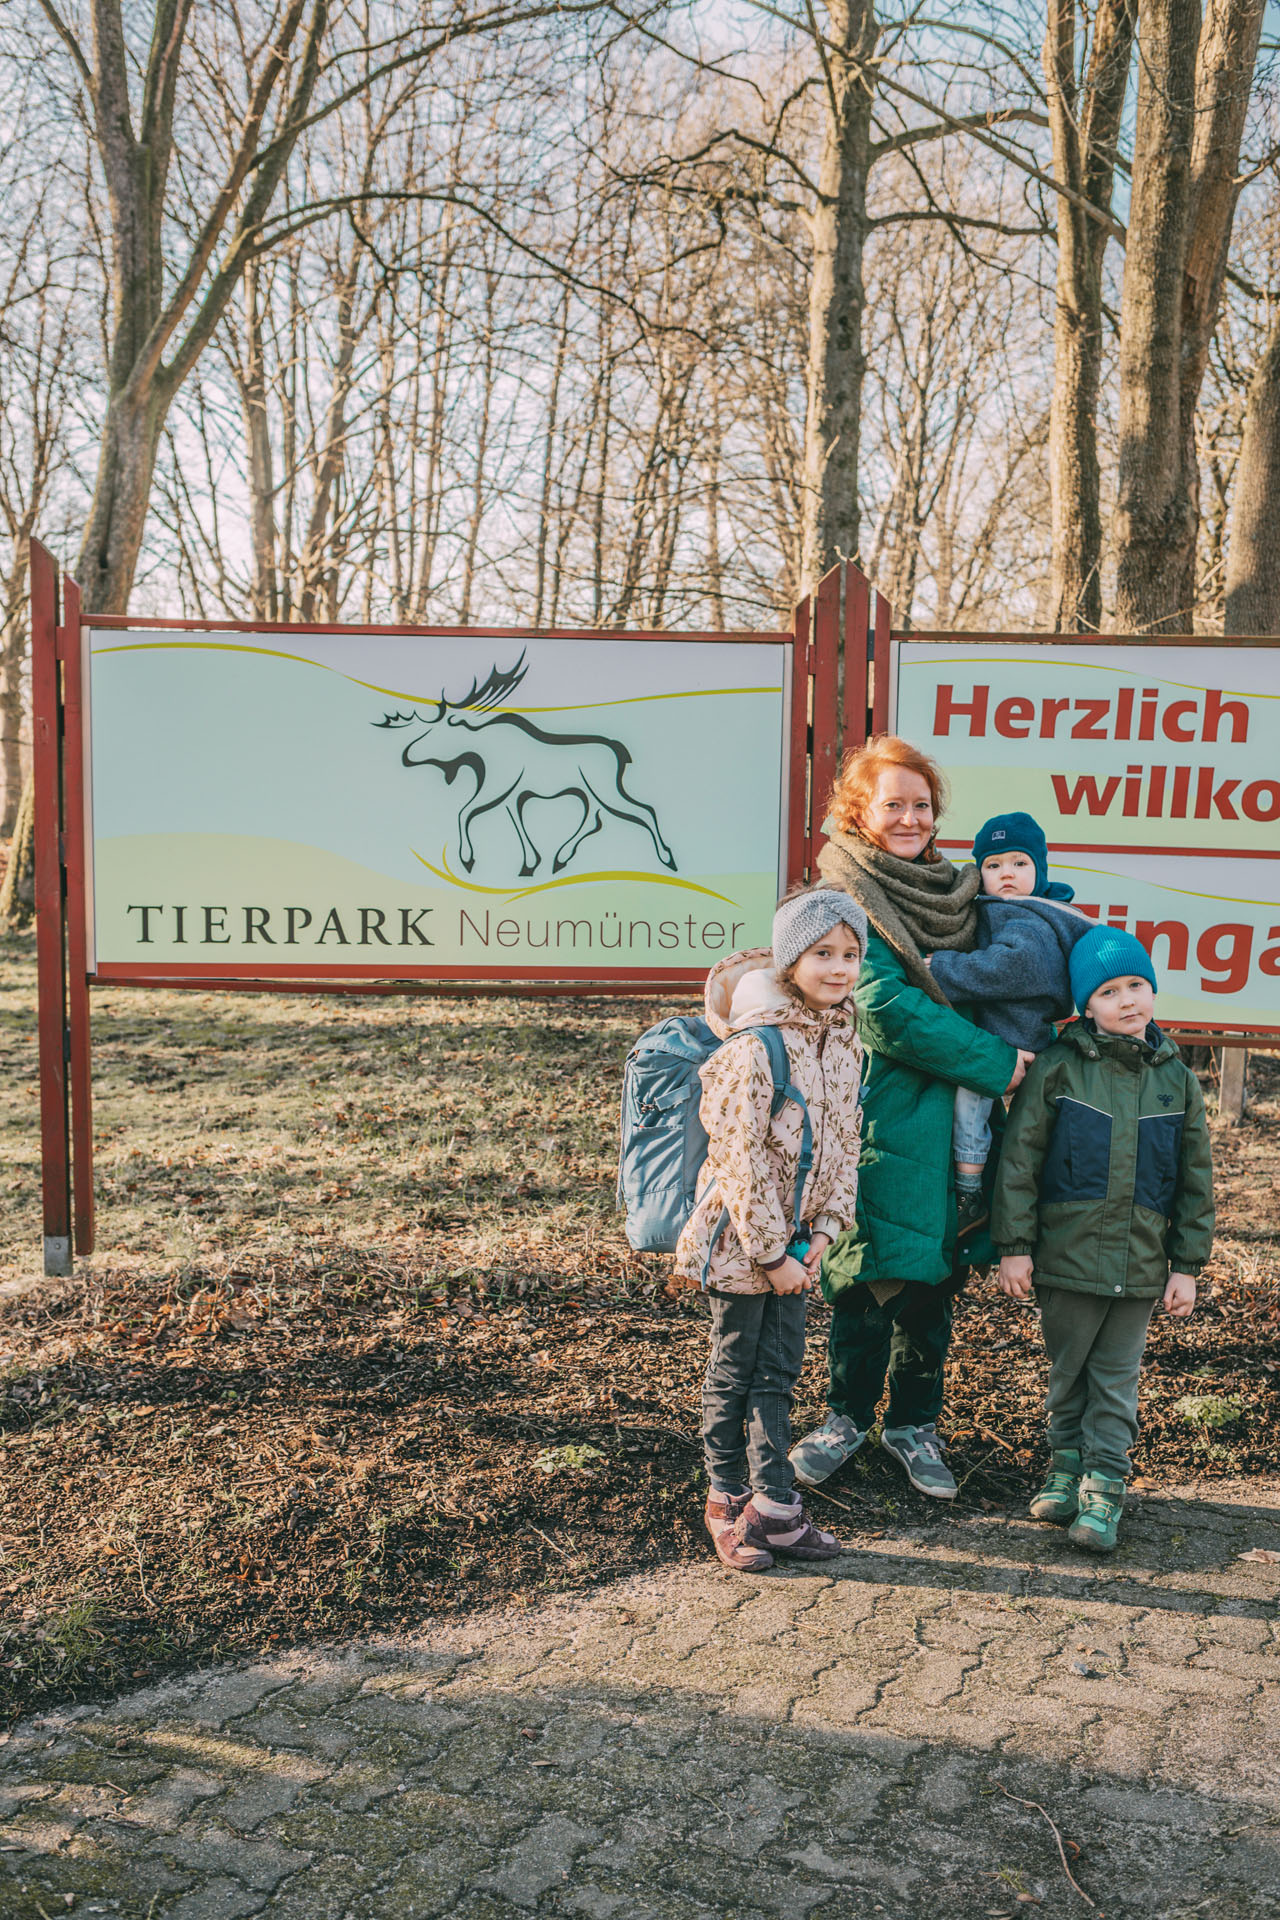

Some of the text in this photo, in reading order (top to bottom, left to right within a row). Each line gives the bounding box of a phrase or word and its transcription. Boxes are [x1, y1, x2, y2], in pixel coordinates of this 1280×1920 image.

[933, 684, 1250, 744] Herzlich
[1050, 764, 1280, 822] willko
[126, 904, 746, 950] TIERPARK Neumünster
